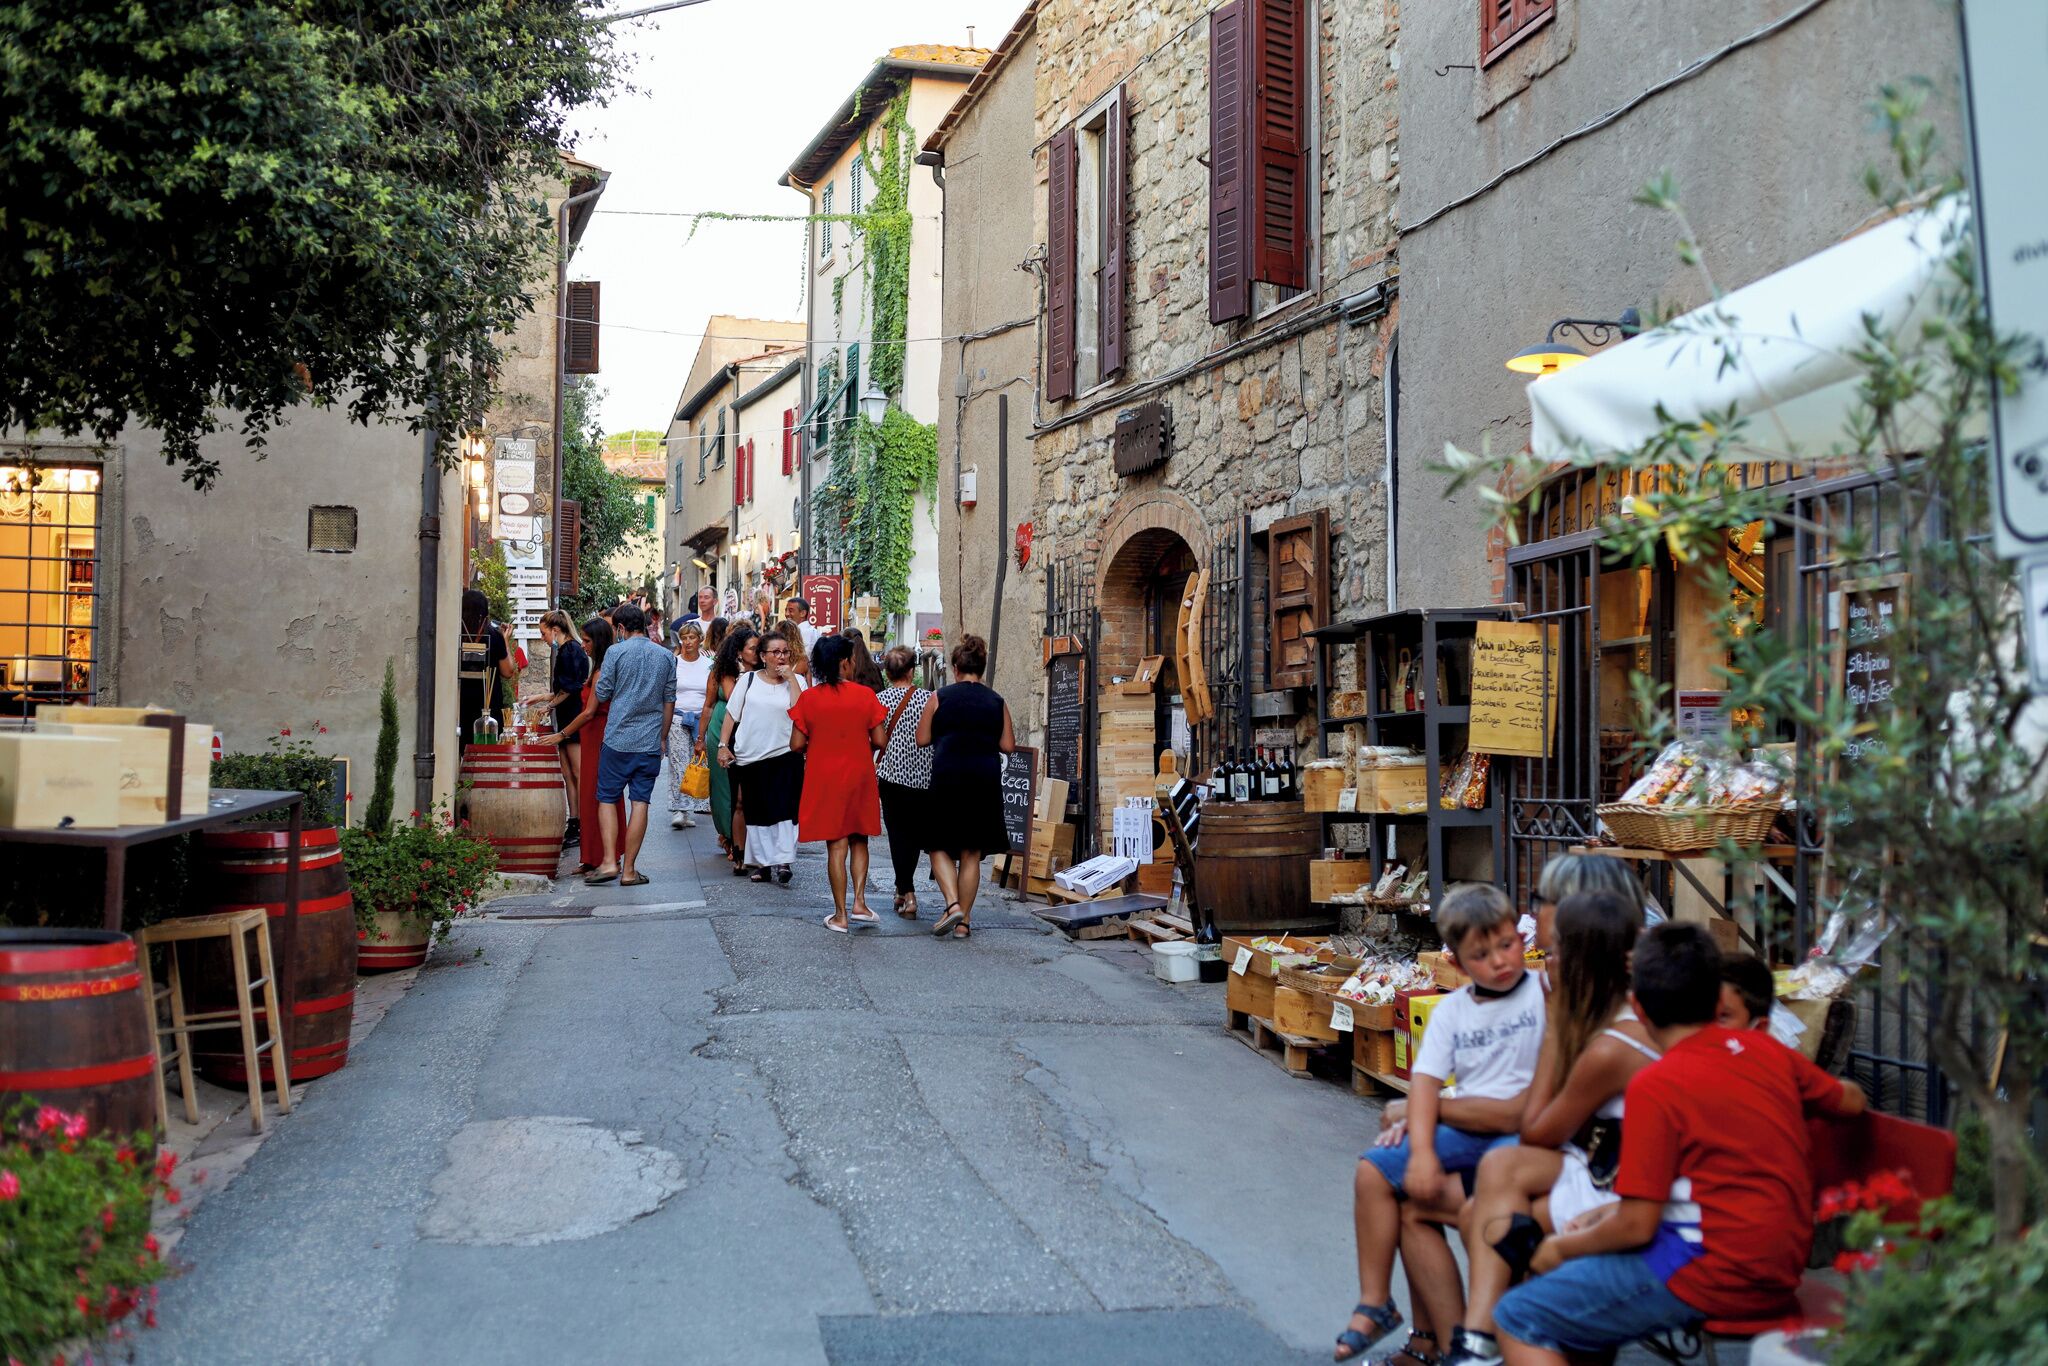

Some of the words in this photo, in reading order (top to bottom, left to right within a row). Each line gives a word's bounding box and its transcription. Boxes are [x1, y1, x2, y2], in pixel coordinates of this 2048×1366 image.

[504, 442, 527, 451] VICOLO
[511, 450, 531, 459] GUSTO
[1001, 773, 1030, 791] teca
